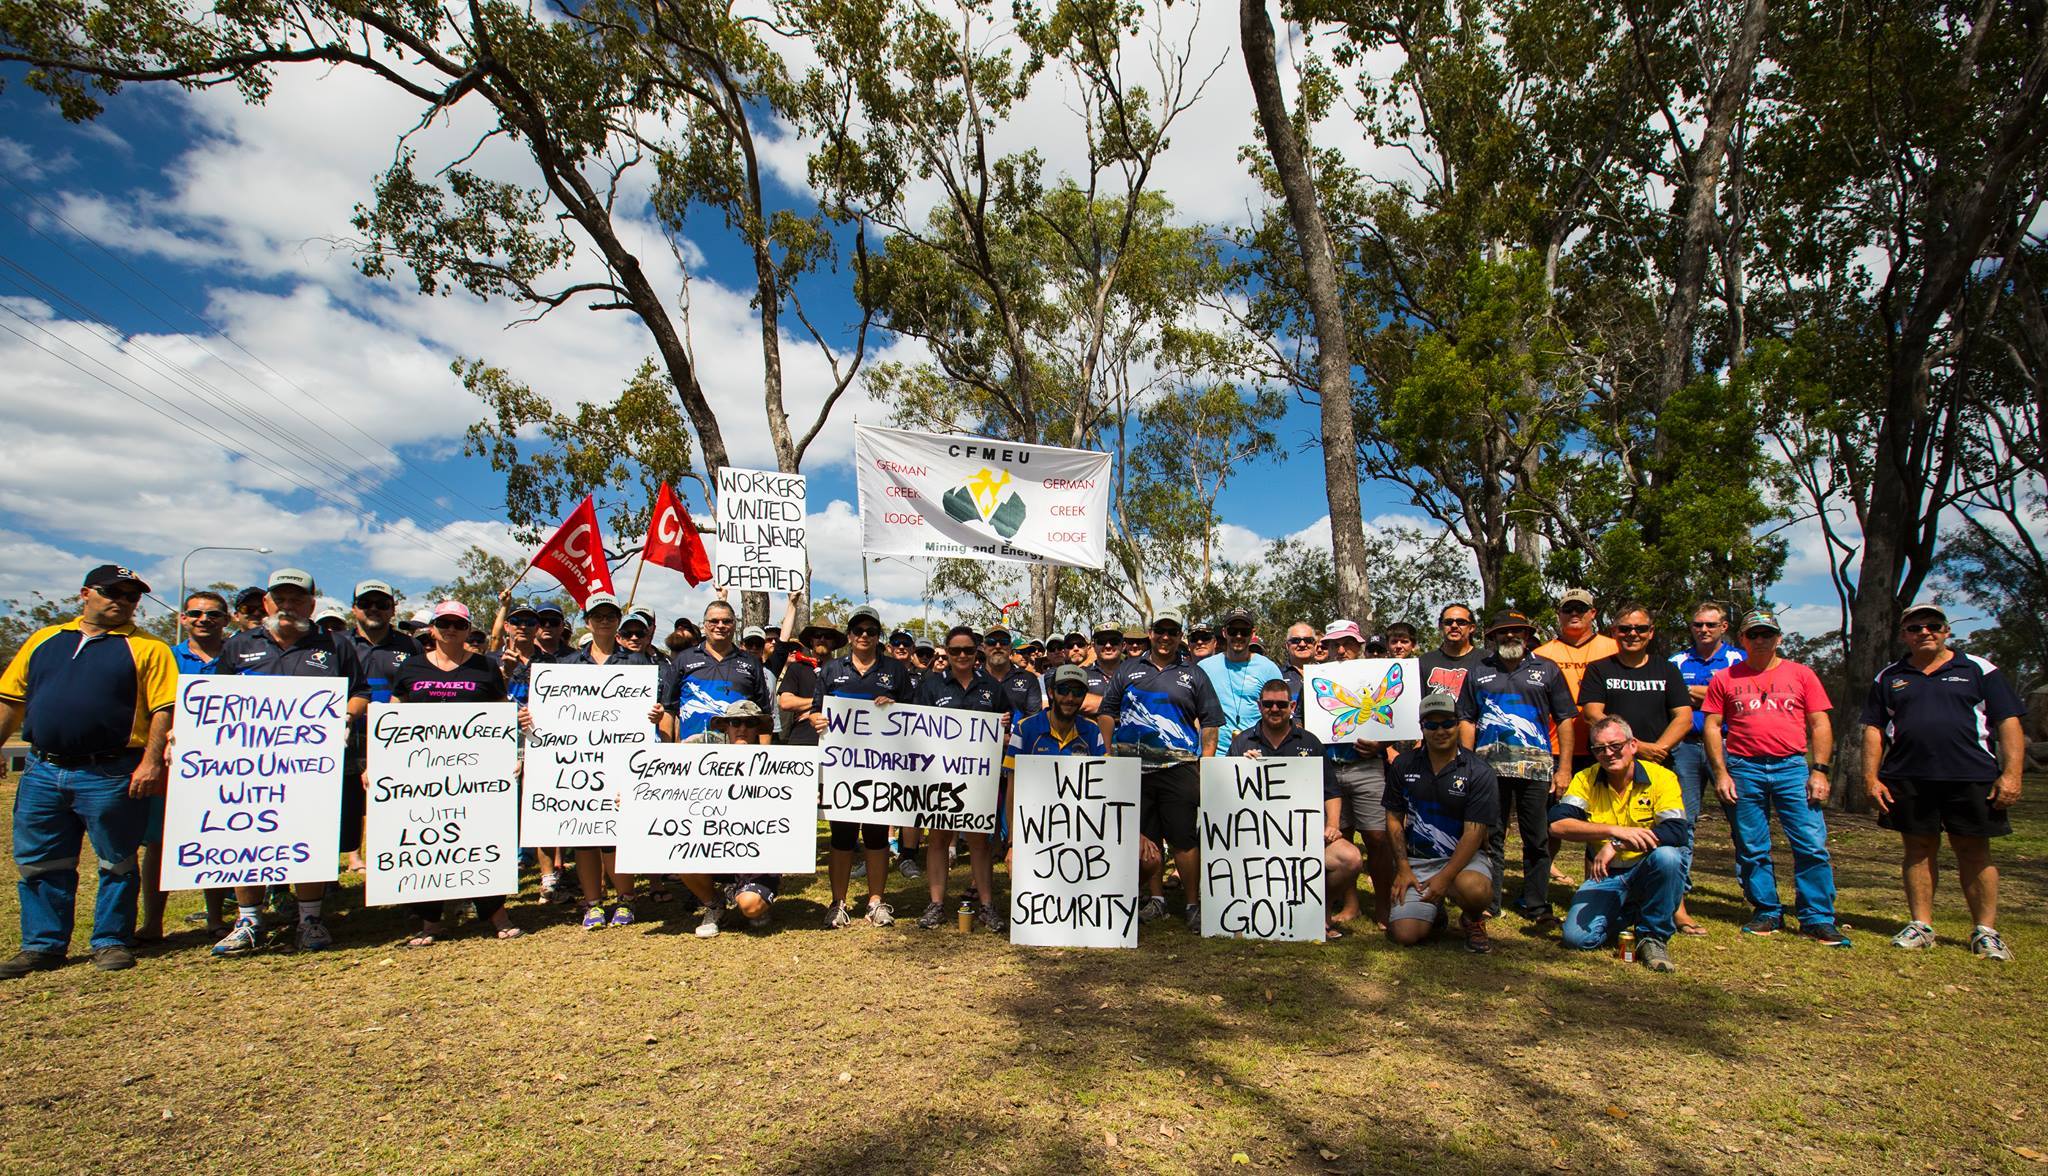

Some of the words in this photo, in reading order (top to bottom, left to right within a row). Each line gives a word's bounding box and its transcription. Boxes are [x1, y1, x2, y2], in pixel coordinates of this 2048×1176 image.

[949, 445, 1030, 464] CFMEU
[876, 459, 927, 477] GERMAN
[719, 469, 806, 499] WORKERS
[886, 486, 921, 499] CREEK
[1043, 478, 1095, 490] GERMAN
[727, 499, 801, 522] UNITED
[884, 513, 924, 526] LODGE
[1050, 505, 1086, 517] CREEK
[718, 522, 756, 544] WILL
[757, 523, 806, 549] NEVER
[1047, 532, 1087, 543] LODGE
[744, 546, 771, 563] BE
[925, 541, 967, 555] Mining
[972, 544, 996, 555] and
[1001, 545, 1044, 561] Energy
[551, 549, 587, 585] Mining
[717, 565, 805, 591] DEFEATED
[412, 681, 476, 691] CFMEU
[534, 669, 600, 702] GERMAN
[601, 673, 653, 699] CREEK
[1606, 678, 1666, 692] SECURITY
[184, 679, 297, 728] GERMAN
[300, 689, 345, 720] CK
[558, 704, 621, 722] MINERS
[216, 722, 327, 748] MINERS
[374, 711, 461, 749] GERMAN
[462, 712, 516, 743] CREEK
[827, 707, 872, 736] WE
[881, 711, 962, 740] STAND
[969, 717, 999, 744] IN
[530, 728, 577, 748] STAND
[589, 728, 645, 745] UNITED
[180, 751, 254, 778] STAND
[258, 752, 335, 776] UNITED
[556, 751, 604, 764] WITH
[629, 750, 692, 780] GERMAN
[698, 751, 745, 777] CREEK
[749, 751, 815, 777] MINEROS
[821, 745, 935, 773] SOLIDARITY
[942, 755, 990, 776] WITH
[374, 776, 441, 802] STAND
[444, 774, 511, 796] UNITED
[556, 769, 605, 791] LOS
[633, 782, 723, 801] PERMANECEN
[728, 783, 793, 801] UNIDOS
[1054, 760, 1106, 801] WE
[1235, 763, 1291, 801] WE
[219, 783, 286, 804] WITH
[818, 779, 872, 811] LOS
[873, 781, 967, 813] BRONCES
[409, 806, 466, 824] WITH
[689, 801, 727, 818] CON
[200, 810, 279, 833] LOS
[558, 817, 617, 836] MINER
[648, 818, 692, 837] LOS
[703, 817, 790, 836] BRONCES
[914, 812, 996, 831] MINEROS
[1019, 801, 1136, 845] WANT
[1203, 807, 1321, 852] WANT
[400, 822, 461, 846] LOS
[178, 842, 310, 867] BRONCES
[378, 844, 500, 871] BRONCES
[669, 841, 760, 860] MINEROS
[1033, 842, 1110, 884] JOB
[195, 866, 287, 884] MINERS
[398, 868, 491, 893] MINERS
[1207, 858, 1235, 898] A
[1243, 856, 1323, 906] FAIR
[1012, 891, 1137, 938] SECURITY
[1220, 899, 1302, 938] GO!!
